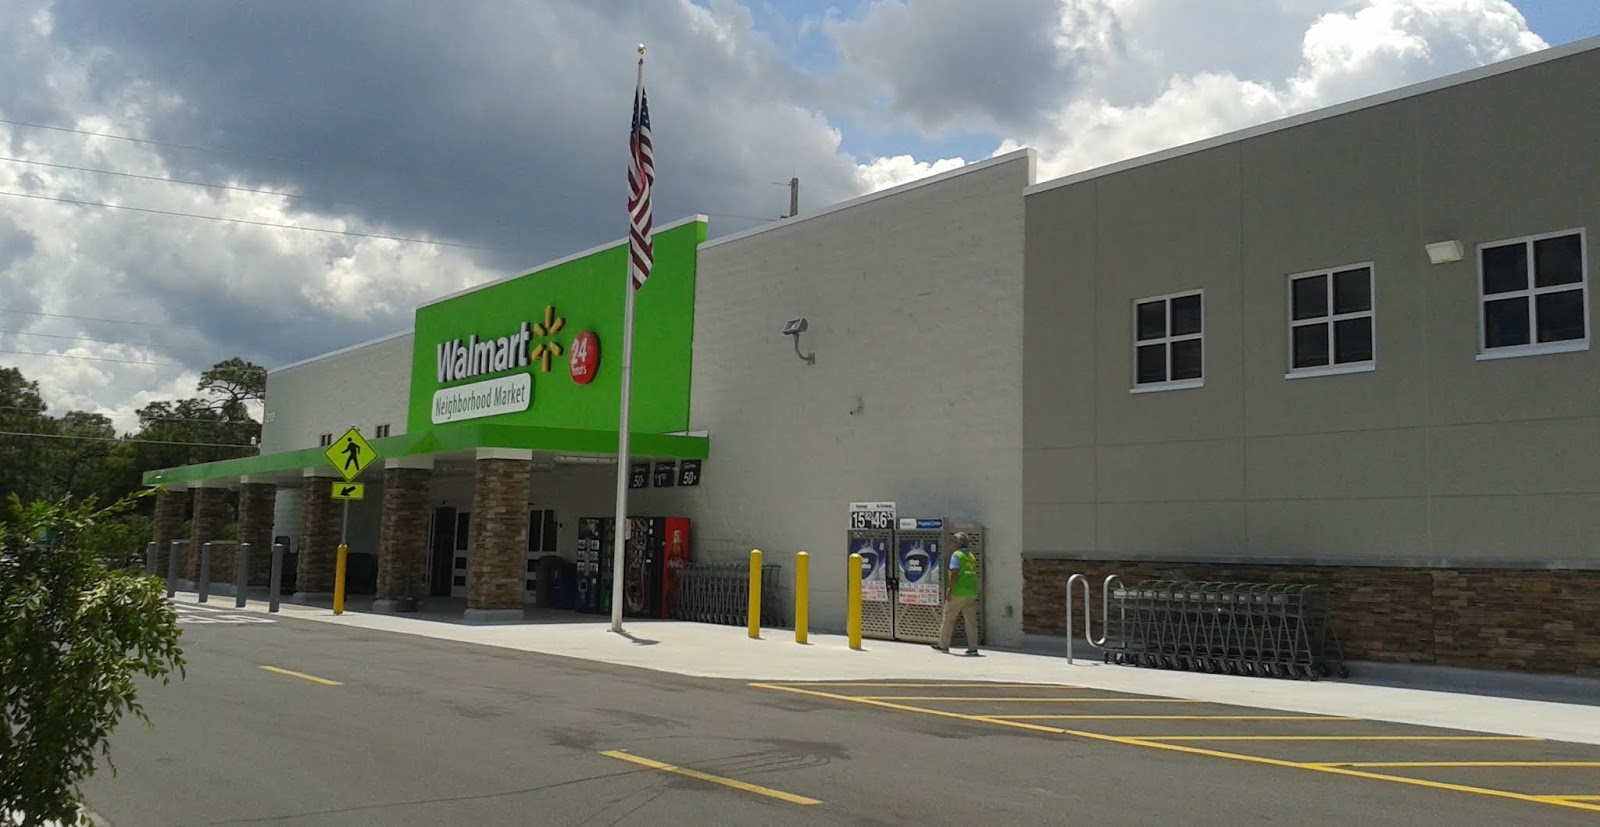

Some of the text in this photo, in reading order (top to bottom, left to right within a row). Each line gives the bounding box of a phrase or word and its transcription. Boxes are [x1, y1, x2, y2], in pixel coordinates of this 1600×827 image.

[437, 321, 530, 383] Walmart
[570, 337, 588, 364] 24
[435, 382, 526, 419] Neighborhood Market
